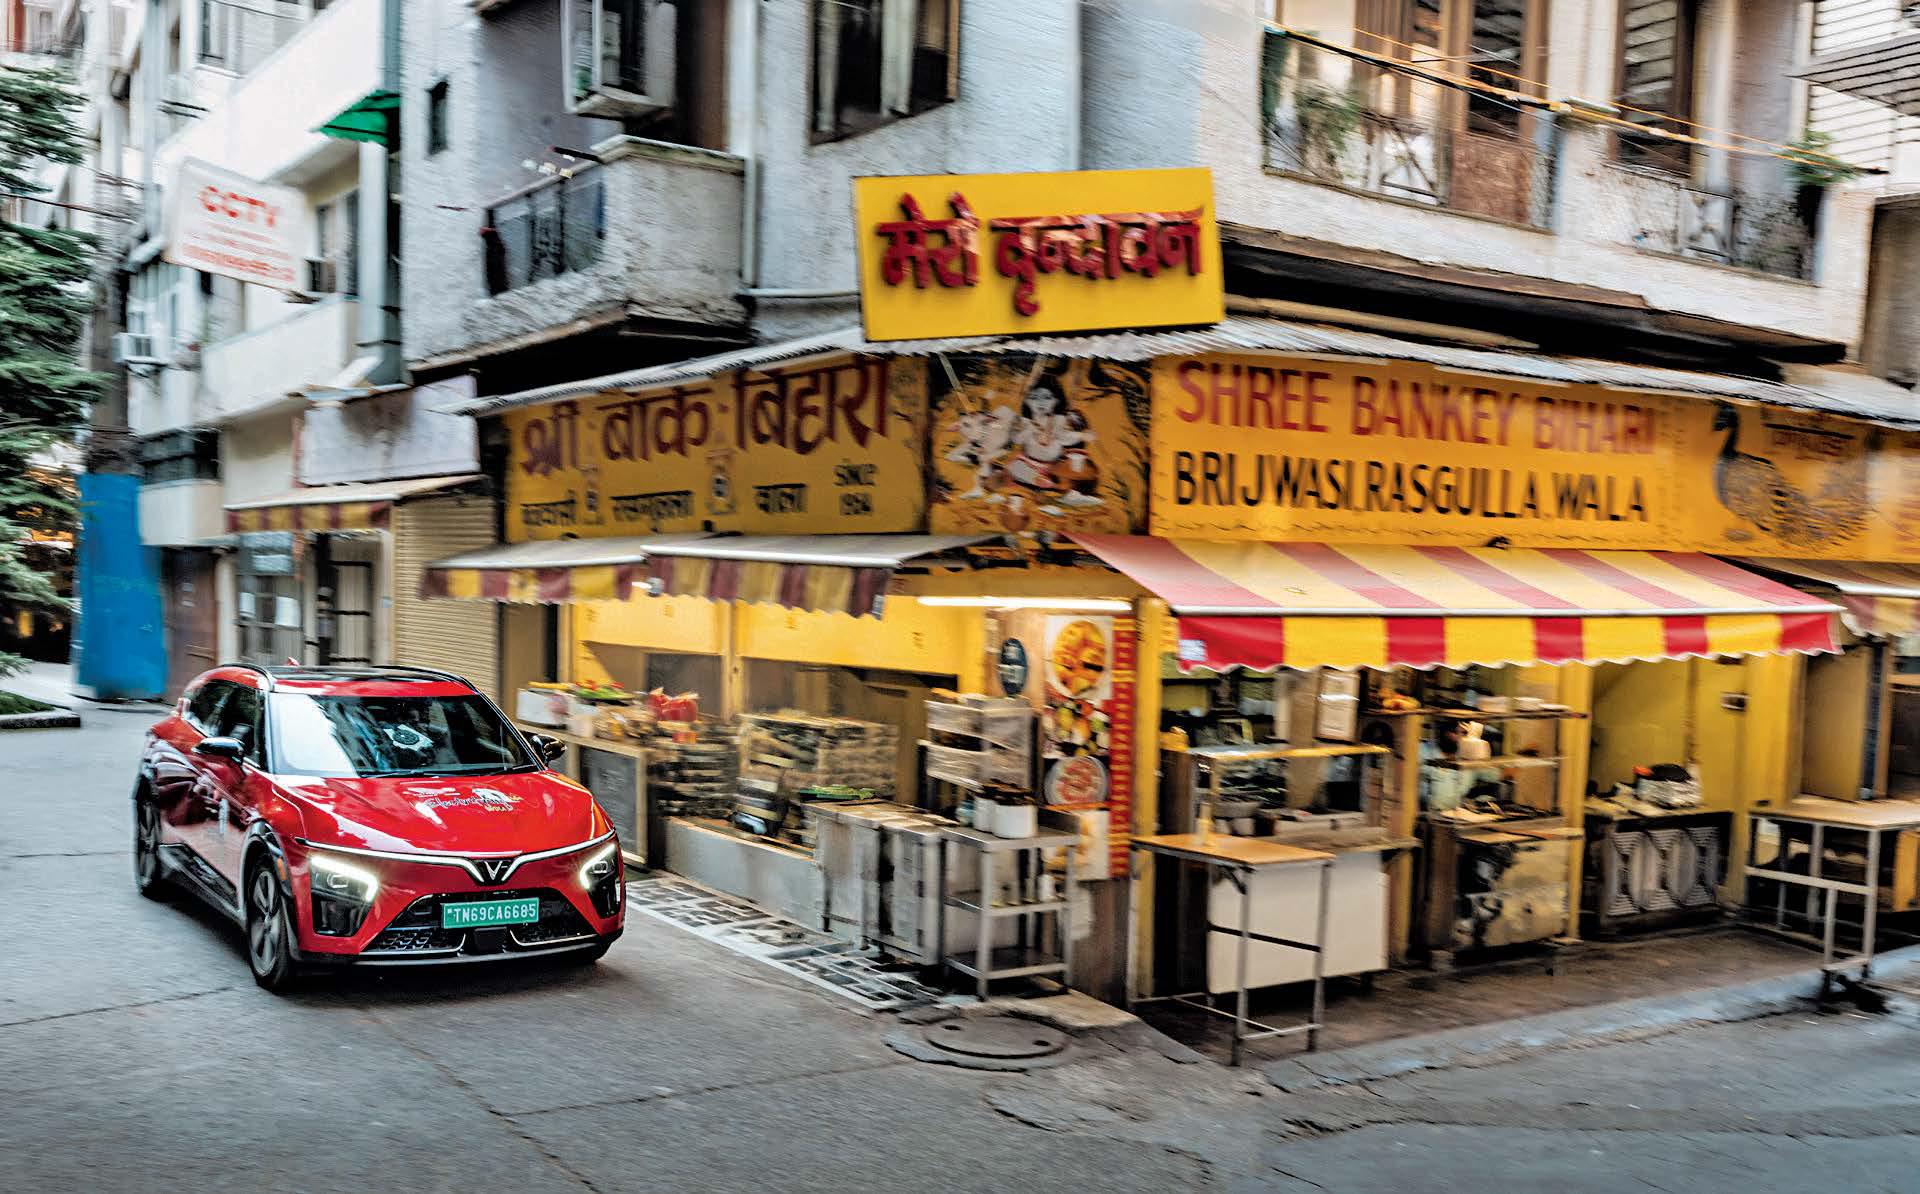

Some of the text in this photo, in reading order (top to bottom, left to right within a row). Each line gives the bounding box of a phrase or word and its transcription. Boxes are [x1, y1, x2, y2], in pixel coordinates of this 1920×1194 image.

[197, 185, 282, 226] CCTV
[876, 191, 1205, 316] मेरो वृन्दावन
[1175, 360, 1656, 454] SHREE BANKEY BIHARI
[453, 903, 537, 923] TN69CA6685
